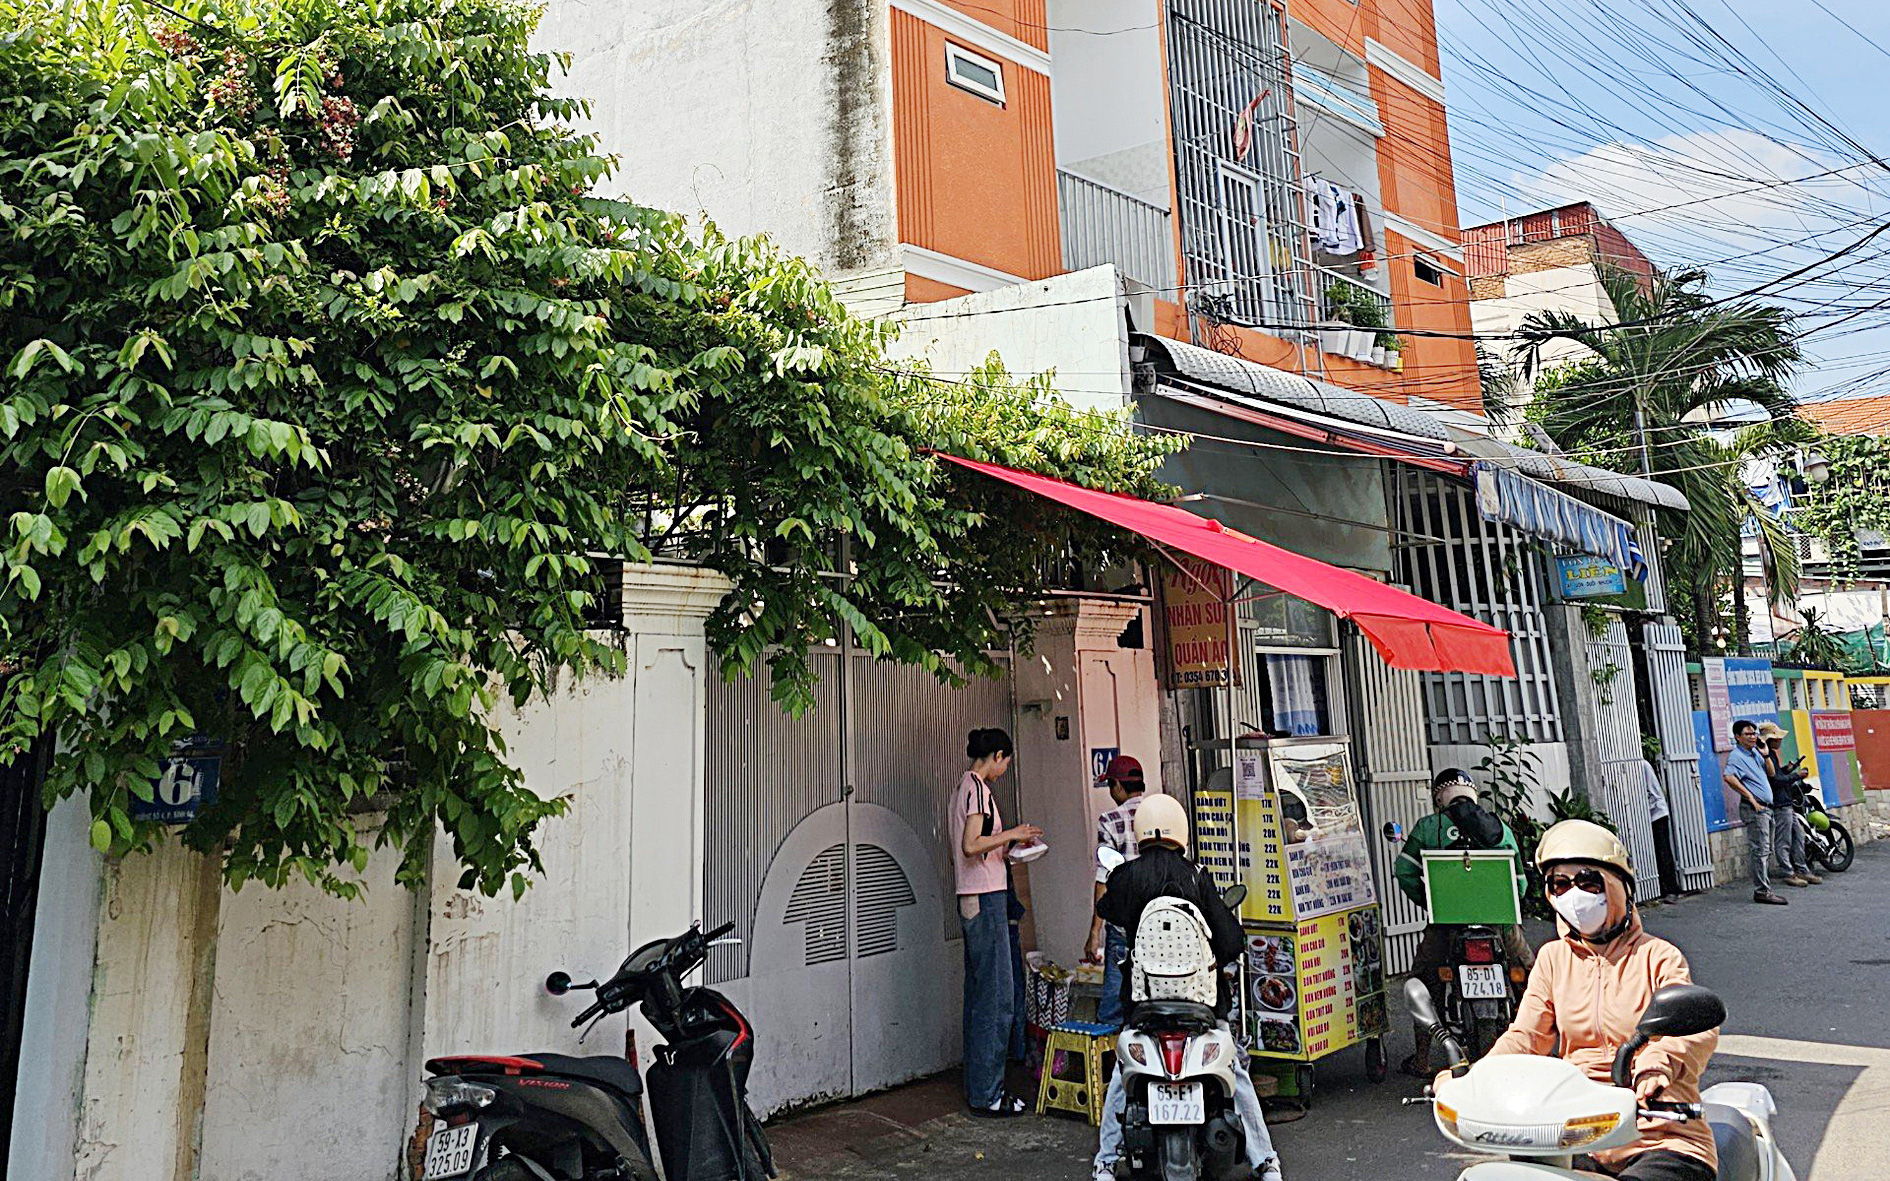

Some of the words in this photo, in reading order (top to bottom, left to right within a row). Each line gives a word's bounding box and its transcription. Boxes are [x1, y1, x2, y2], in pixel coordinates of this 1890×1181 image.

[1167, 600, 1202, 630] NHẬN
[1261, 799, 1273, 808] 17K
[1263, 814, 1273, 823] 17K
[1263, 828, 1277, 838] 20K
[1264, 844, 1277, 853] 22K
[1266, 858, 1279, 868] 22K
[1266, 874, 1280, 884] 22K
[1267, 889, 1281, 899] 22K
[1268, 904, 1281, 914] 22K
[1464, 982, 1503, 996] 724.18
[520, 1078, 570, 1090] VISION
[1154, 1103, 1201, 1121] 167.22
[437, 1127, 470, 1154] 59-X3
[429, 1149, 469, 1177] 325.09
